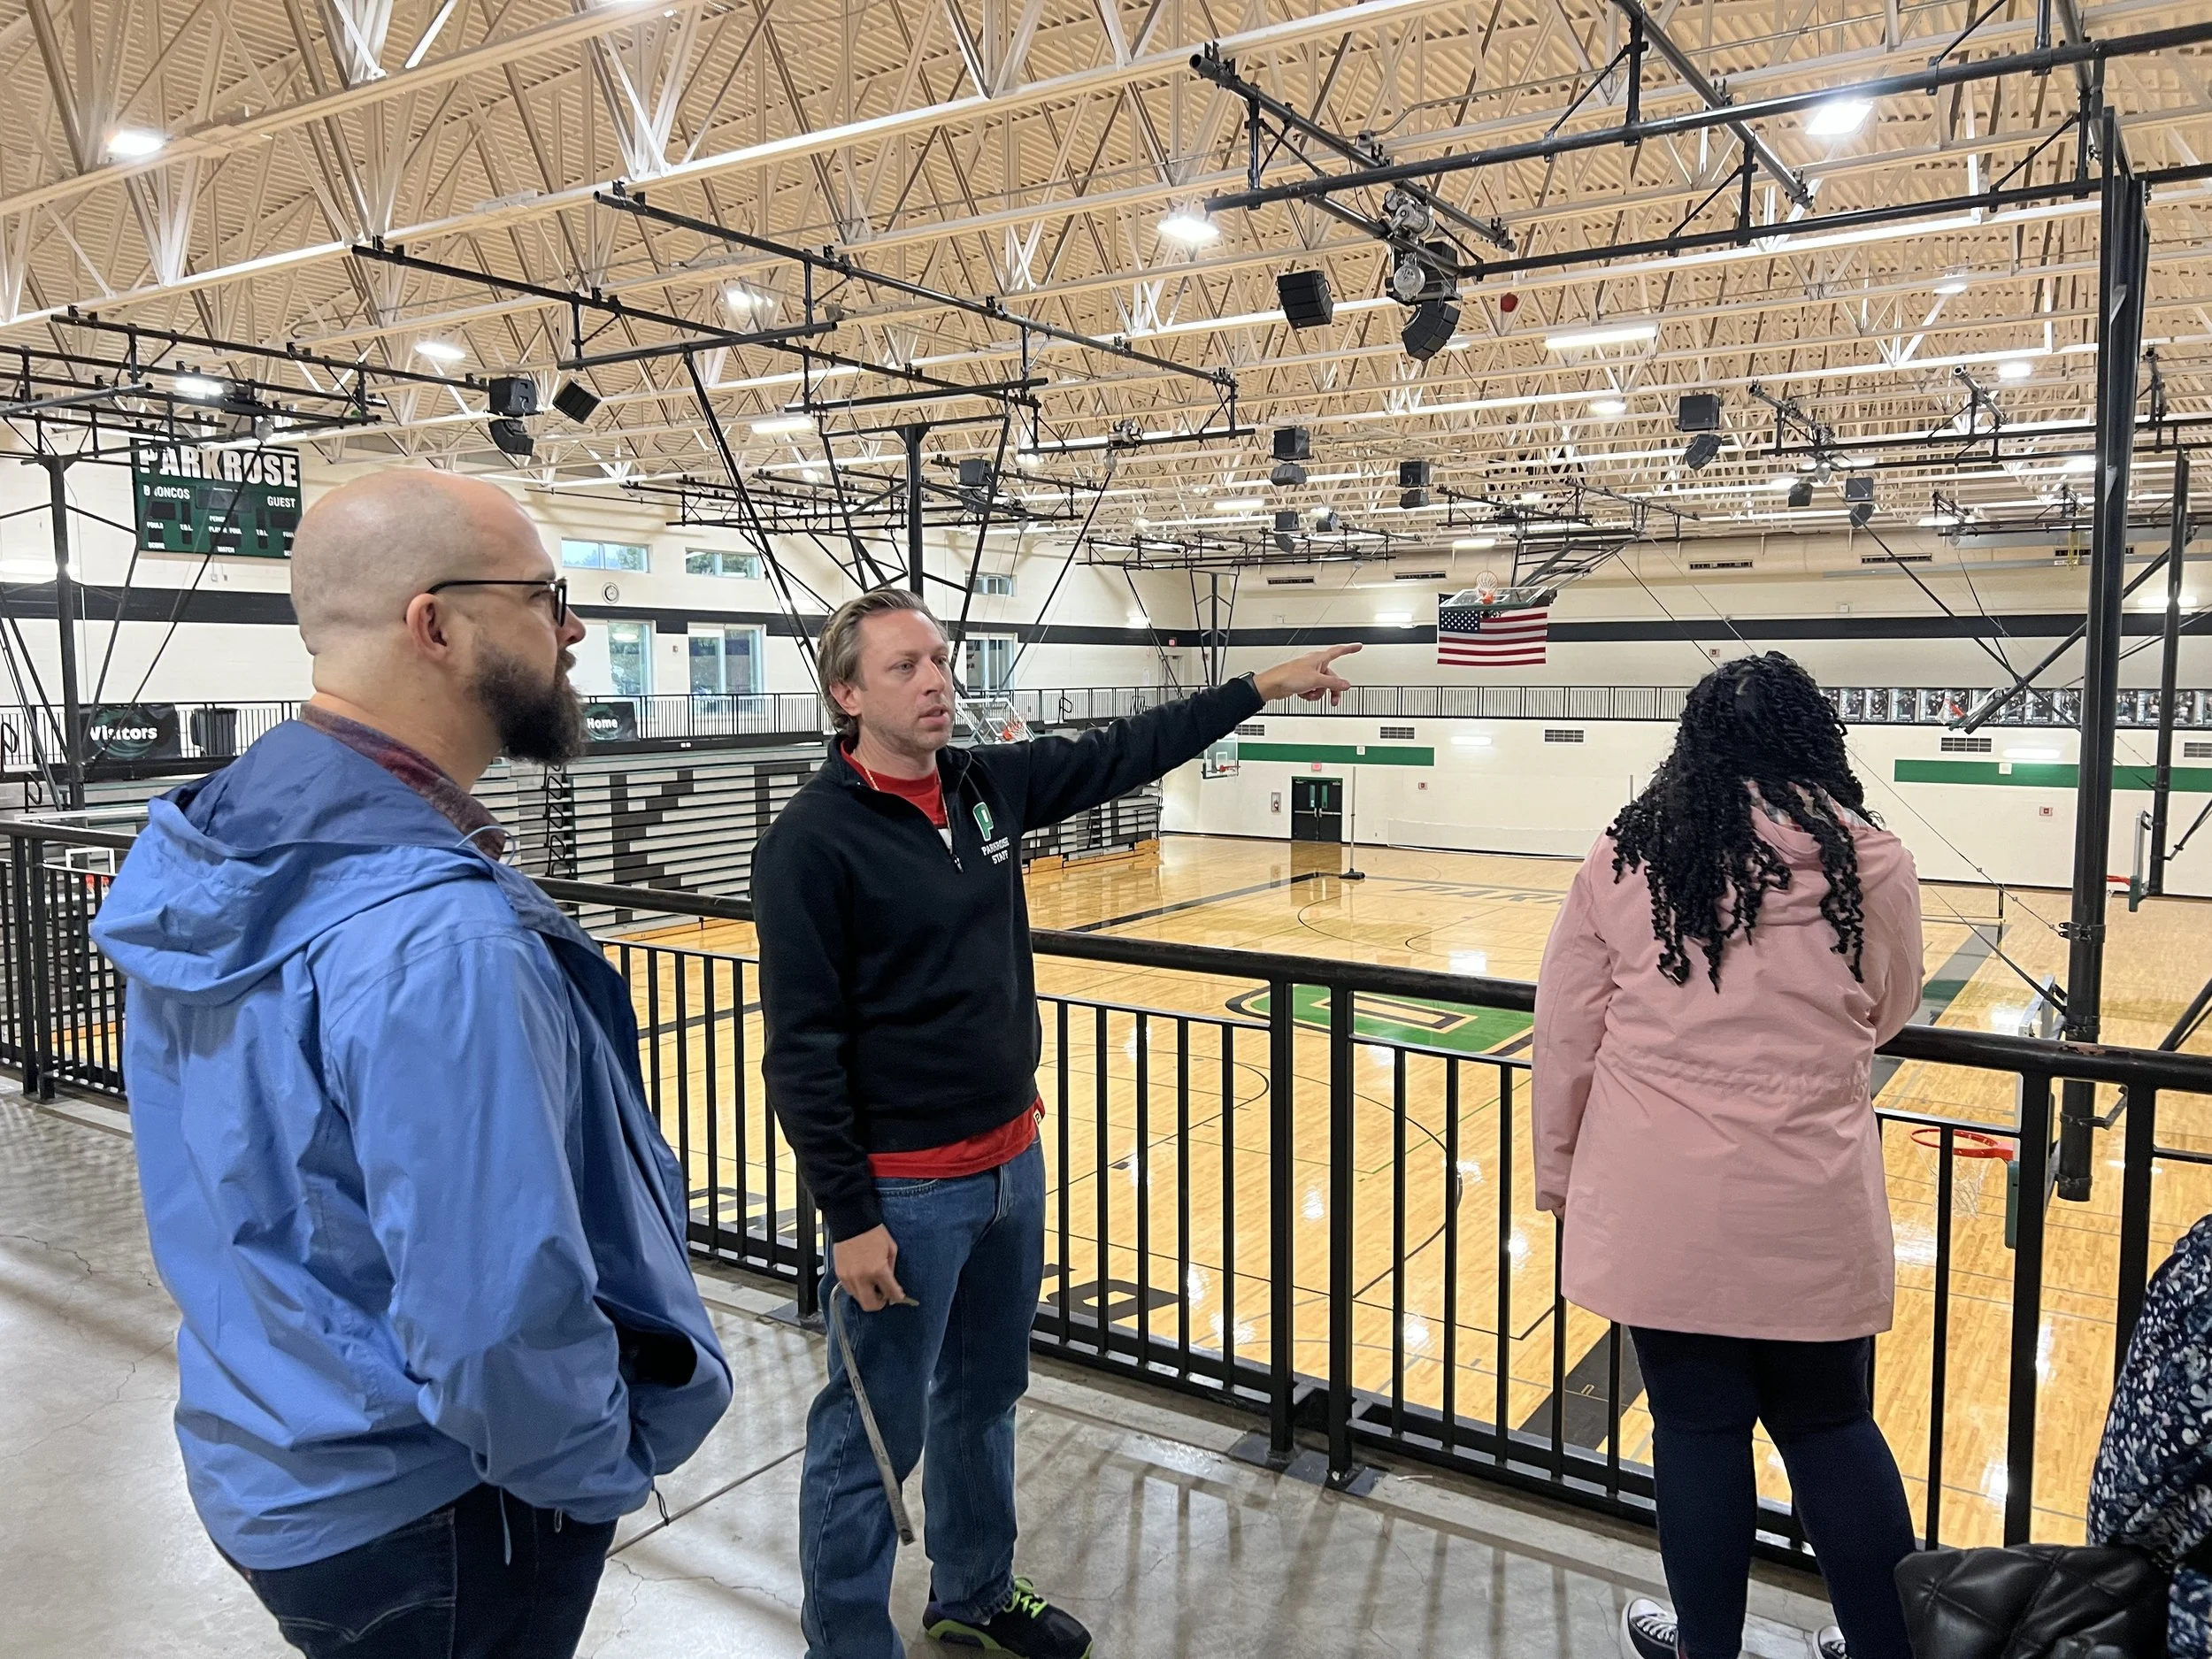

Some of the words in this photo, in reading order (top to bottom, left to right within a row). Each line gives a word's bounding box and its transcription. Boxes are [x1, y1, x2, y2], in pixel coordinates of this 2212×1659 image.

[138, 440, 298, 488] PARKROSE
[143, 484, 191, 500] BONCOS
[266, 495, 296, 509] GUEST
[586, 718, 618, 729] Home
[89, 725, 158, 741] Visitors
[991, 849, 1010, 864] STAFF
